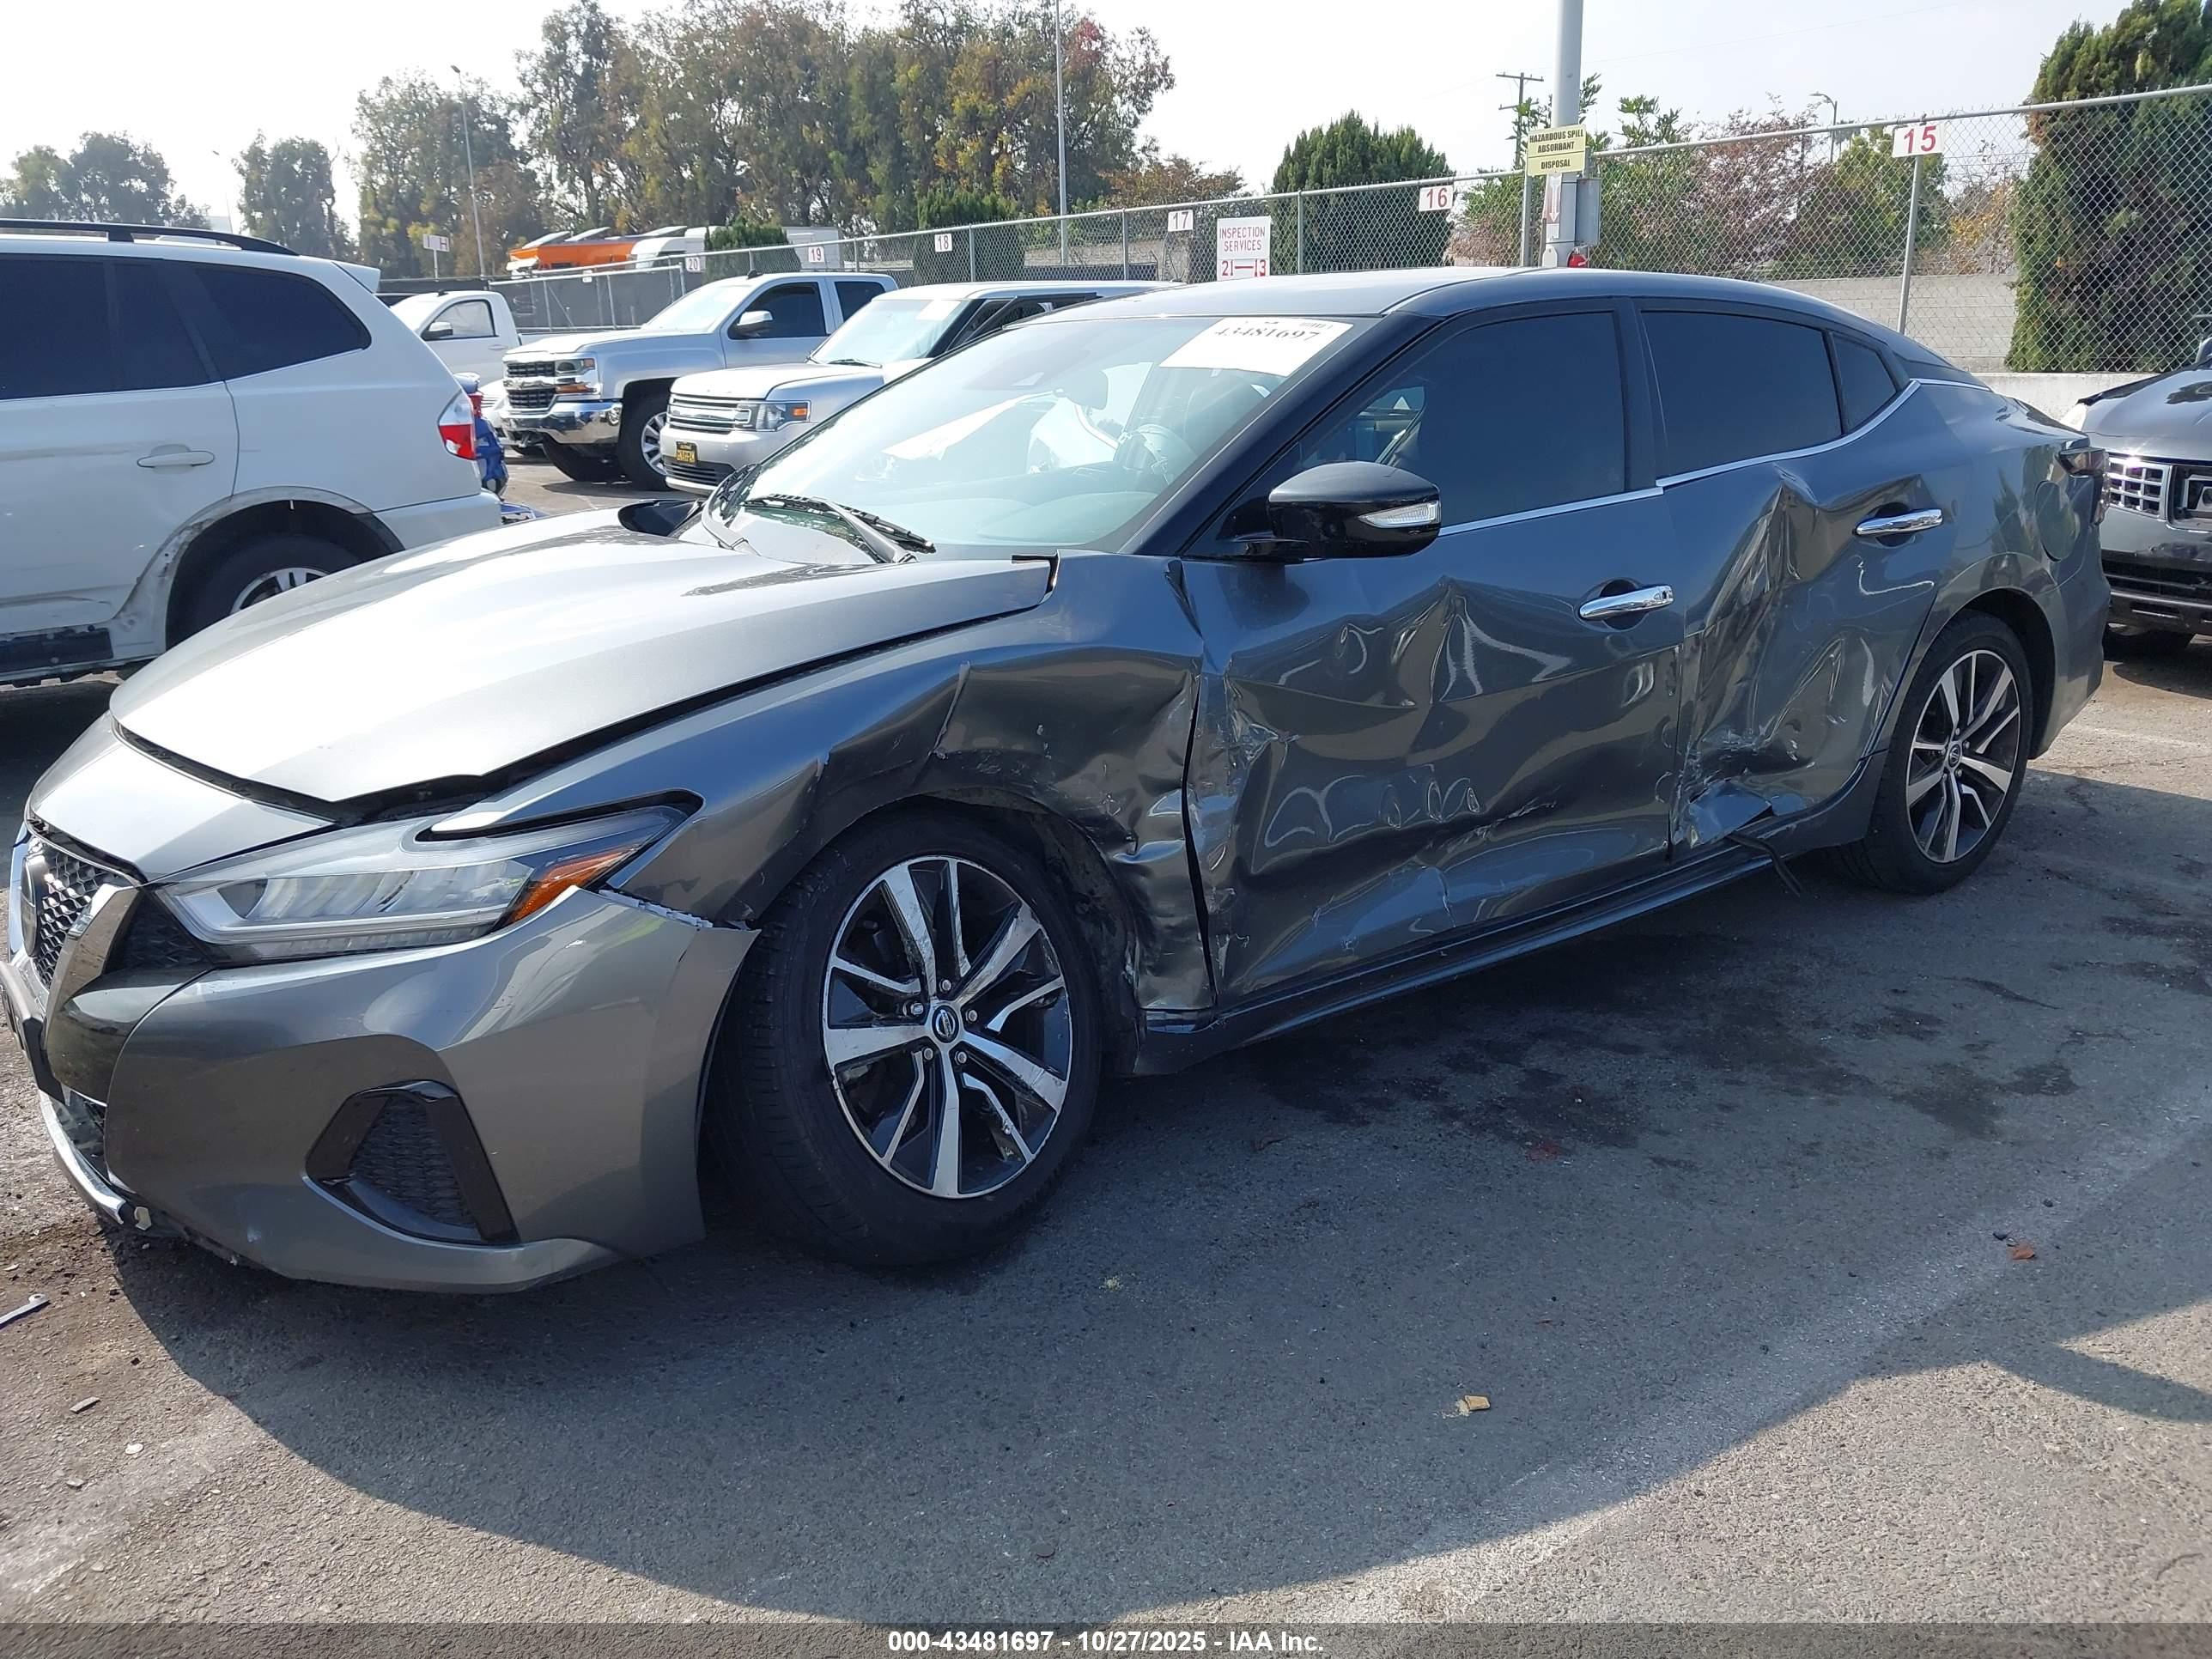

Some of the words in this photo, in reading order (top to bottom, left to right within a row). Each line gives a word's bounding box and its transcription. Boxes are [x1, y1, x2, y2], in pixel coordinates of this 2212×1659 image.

[1529, 131, 1566, 143] HAZARDOUS
[1567, 129, 1584, 139] SPILL
[1904, 125, 1936, 154] 15
[1537, 141, 1575, 153] ABSORBANT
[1540, 158, 1571, 170] DISPOSAL
[1426, 187, 1448, 209] 16
[1173, 211, 1188, 229] 17
[1219, 226, 1265, 239] INSPECTION
[939, 234, 949, 250] 18
[1224, 240, 1262, 252] SERVICES
[811, 247, 822, 261] 19
